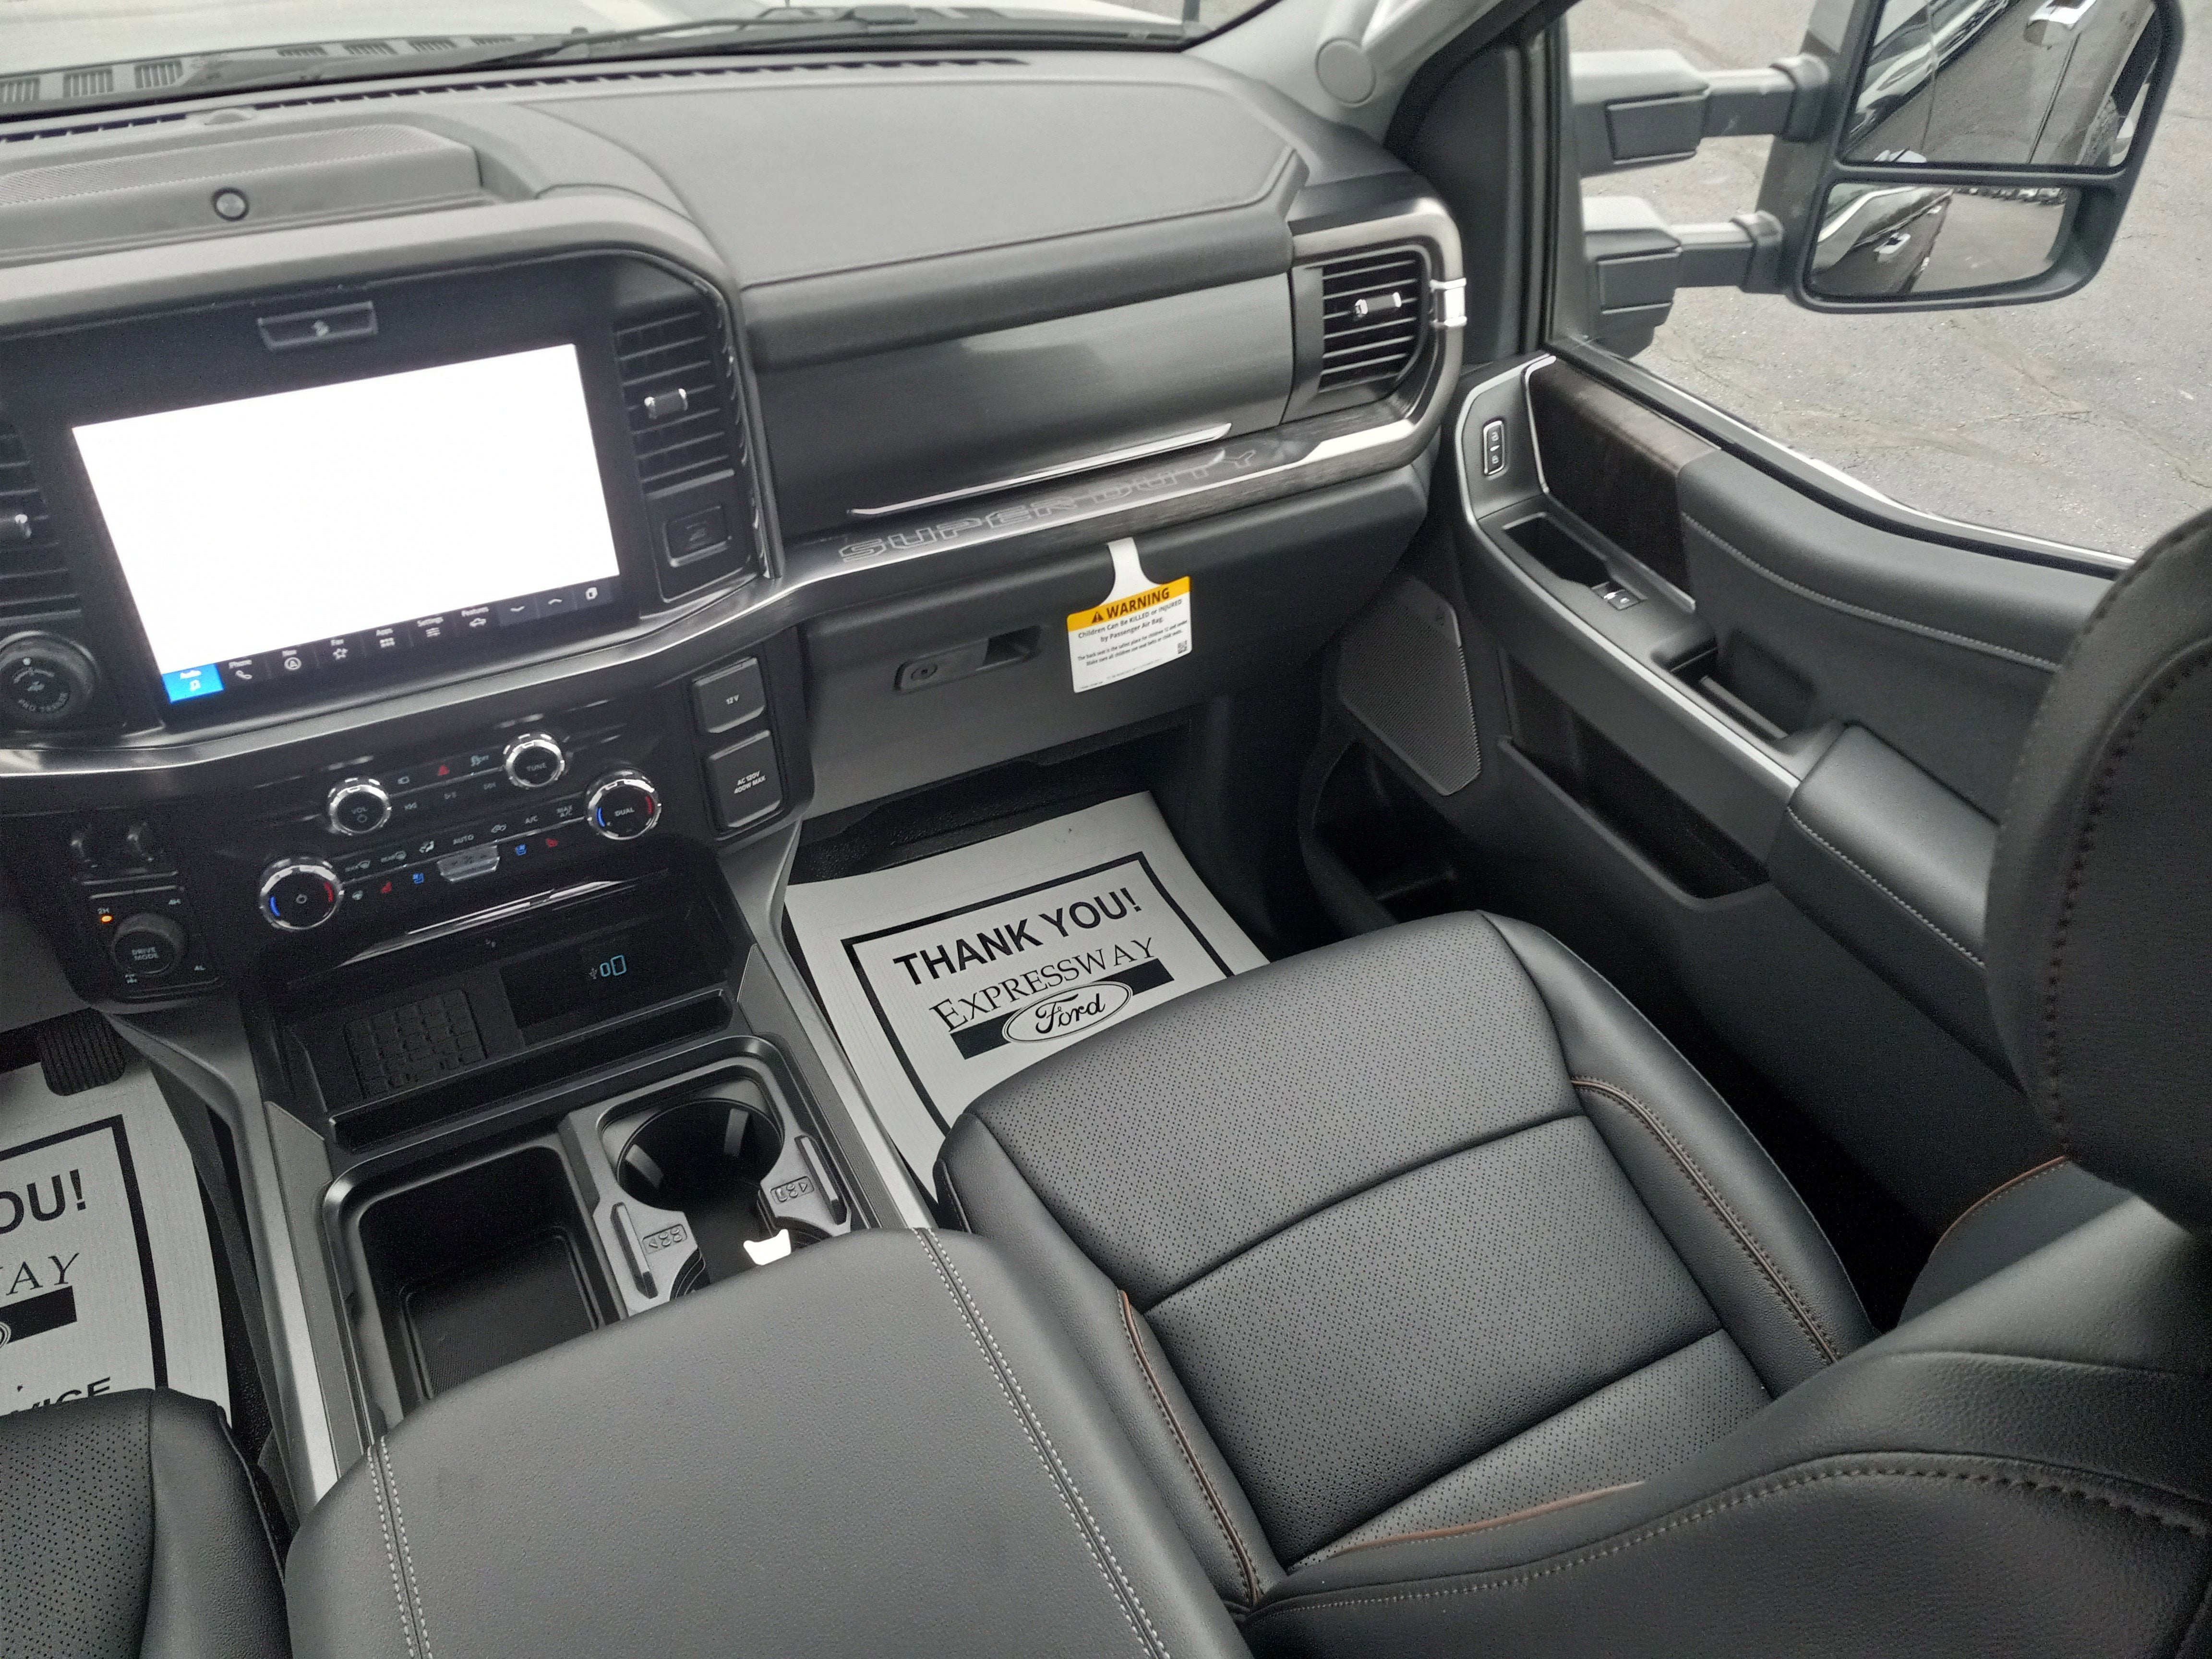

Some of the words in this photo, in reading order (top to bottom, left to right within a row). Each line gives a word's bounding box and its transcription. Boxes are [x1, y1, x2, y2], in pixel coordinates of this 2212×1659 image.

[838, 496, 1078, 563] SUPER
[1087, 449, 1256, 504] DUTY
[1106, 587, 1169, 619] WARNING
[1078, 627, 1105, 638] Children
[1129, 612, 1149, 623] KILLED
[1158, 599, 1182, 612] INJURED
[1109, 625, 1140, 639] Passenger
[228, 660, 252, 669] Phone
[726, 694, 739, 705] 12V
[526, 763, 547, 771] TUNE
[734, 781, 752, 794] 400W
[752, 774, 767, 786] MAX
[736, 777, 746, 786] AC
[746, 770, 760, 782] 120V
[614, 806, 635, 817] DUAL
[525, 815, 538, 824] A/C
[453, 833, 474, 845] AUTO
[892, 918, 1044, 986] THANK
[1039, 887, 1142, 938] YOU!
[132, 947, 156, 956] DRIVE
[134, 952, 159, 961] MODE
[929, 937, 1155, 1032] EXPRESSWAY
[1034, 993, 1107, 1035] Ford
[0, 1252, 80, 1296] AY
